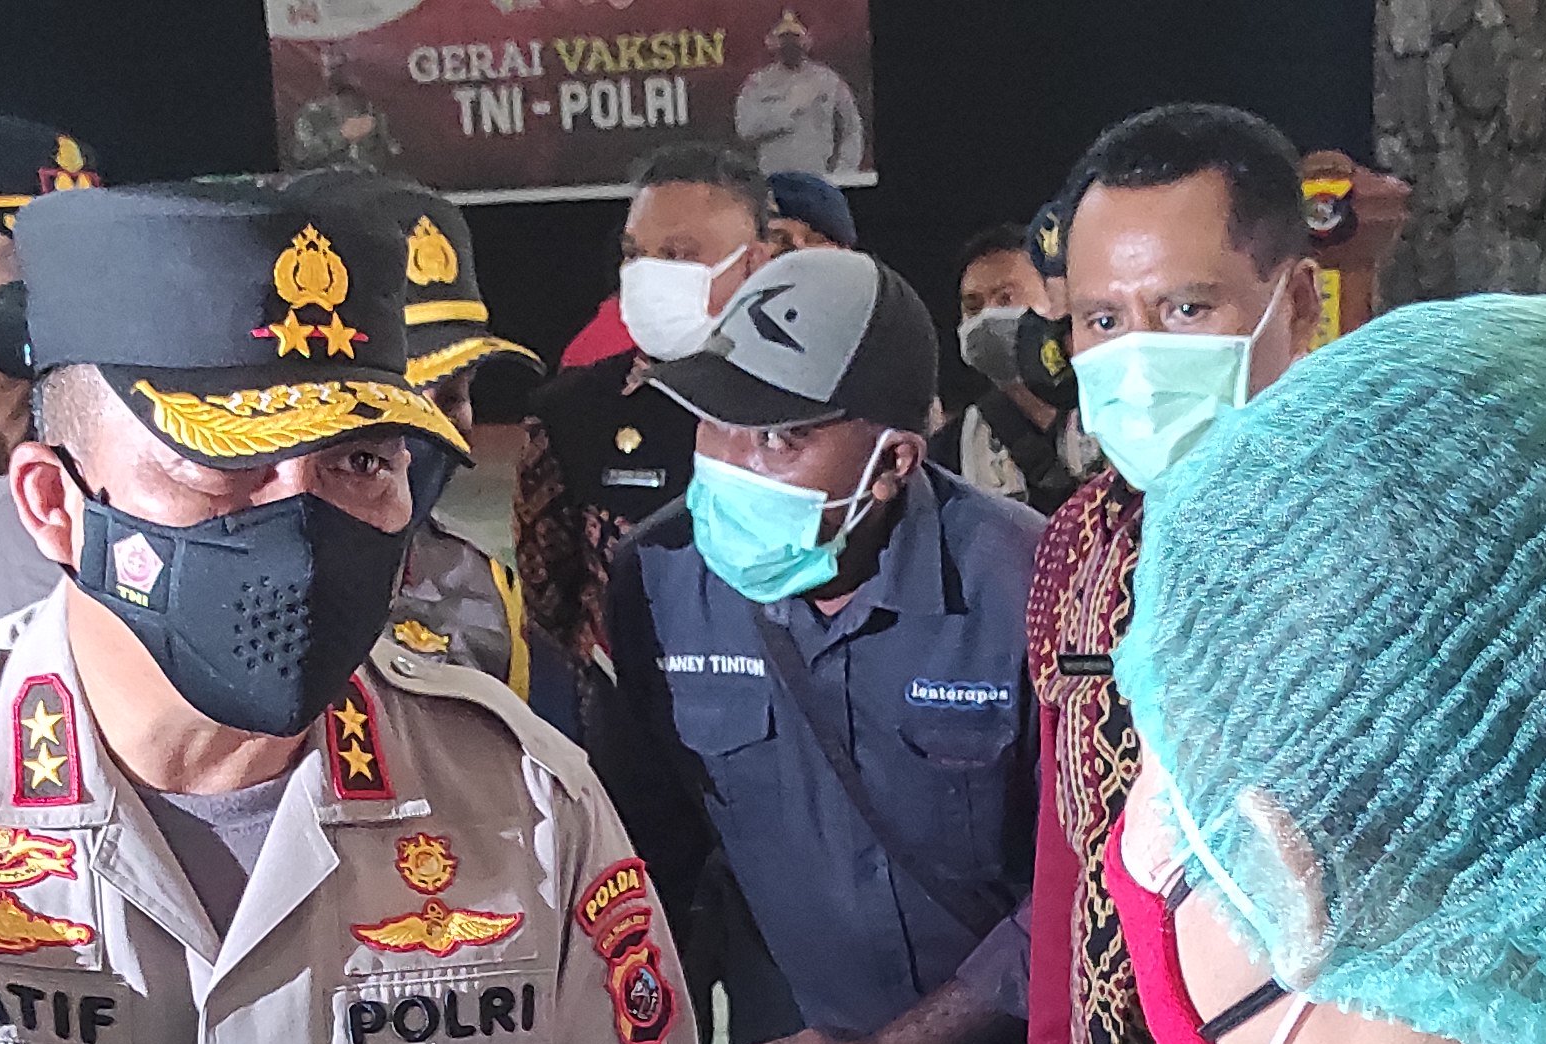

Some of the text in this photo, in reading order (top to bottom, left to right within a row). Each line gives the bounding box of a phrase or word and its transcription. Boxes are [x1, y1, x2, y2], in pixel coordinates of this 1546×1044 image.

[408, 28, 726, 82] GERAI VAKSIN
[454, 84, 525, 136] TNI
[559, 75, 690, 132] POLRI
[116, 584, 149, 608] TNI
[585, 868, 640, 922] POLDA
